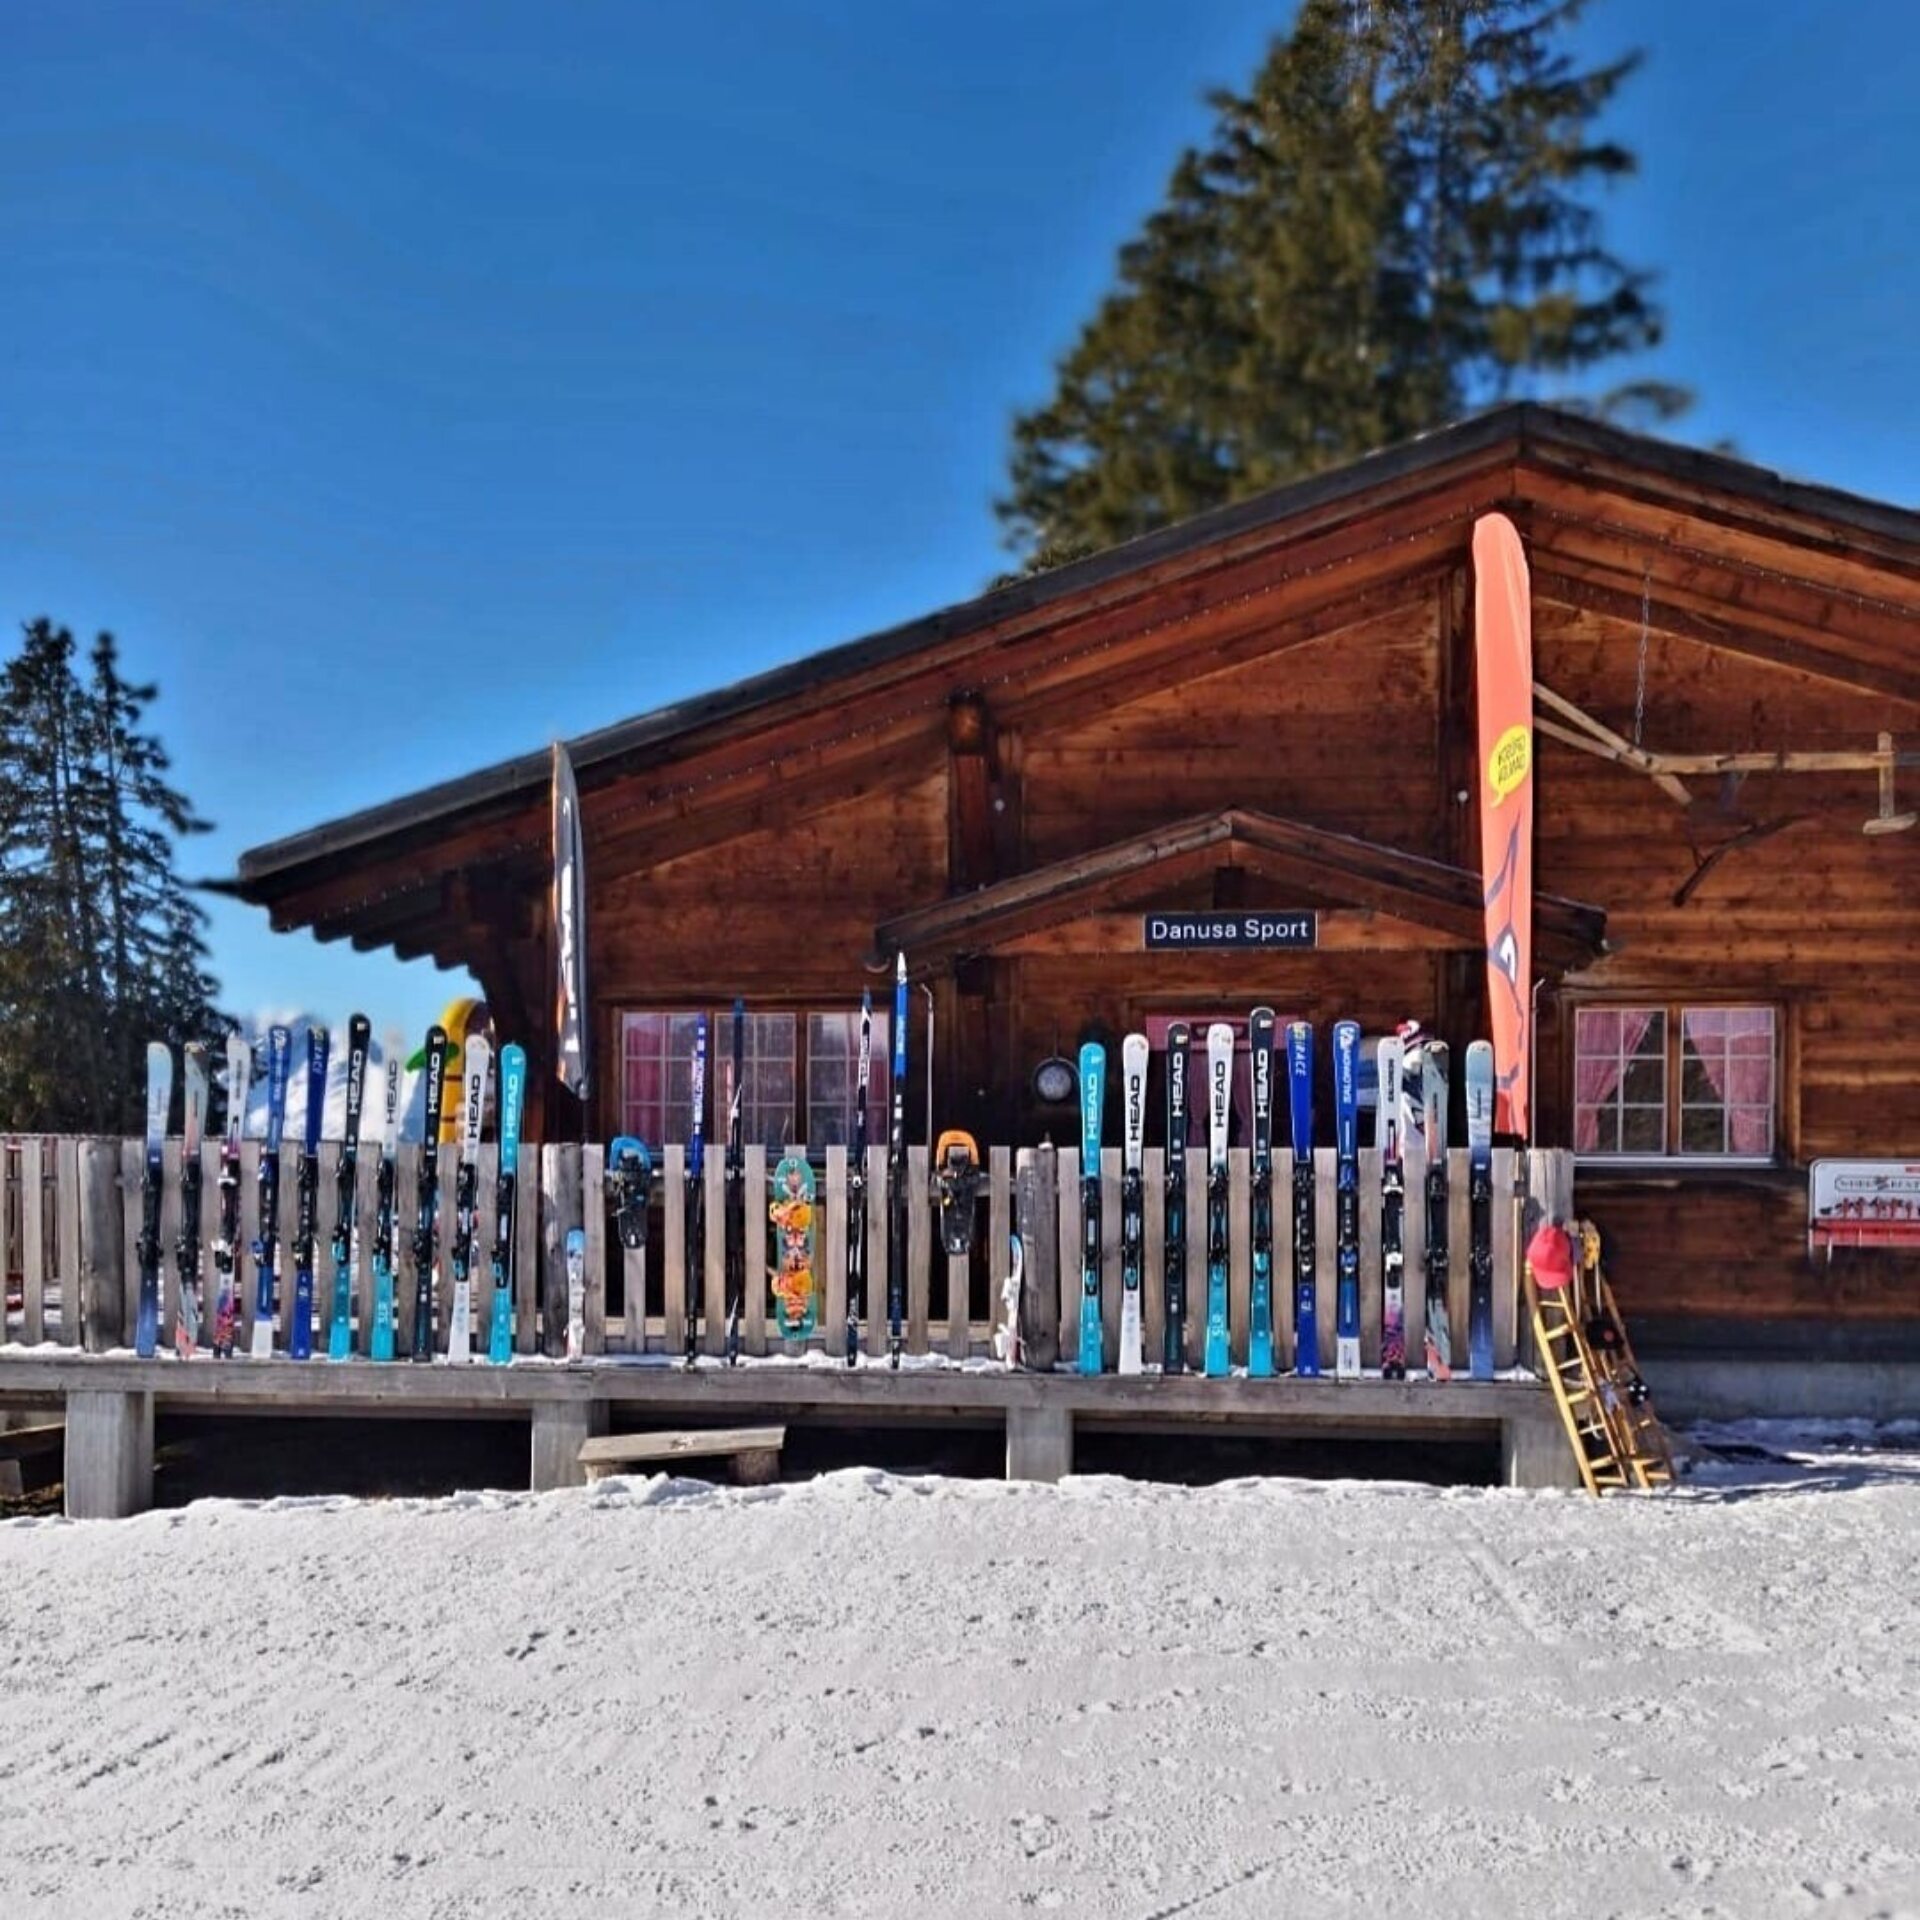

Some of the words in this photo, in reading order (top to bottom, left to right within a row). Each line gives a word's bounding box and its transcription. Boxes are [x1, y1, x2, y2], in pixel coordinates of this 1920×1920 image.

[1152, 920, 1237, 940] Danusa
[1244, 919, 1308, 942] Sport
[349, 1050, 362, 1115] HEAD
[386, 1060, 398, 1124] HEAD
[428, 1052, 440, 1114] HEAD
[468, 1075, 480, 1139] HEAD
[506, 1074, 518, 1138] HEAD
[1087, 1075, 1098, 1140] HEAD
[1130, 1075, 1141, 1142] HEAD
[1172, 1052, 1183, 1117] HEAD
[1215, 1060, 1226, 1128] HEAD
[1257, 1049, 1269, 1118] HEAD
[1343, 1049, 1353, 1105] SALOMON
